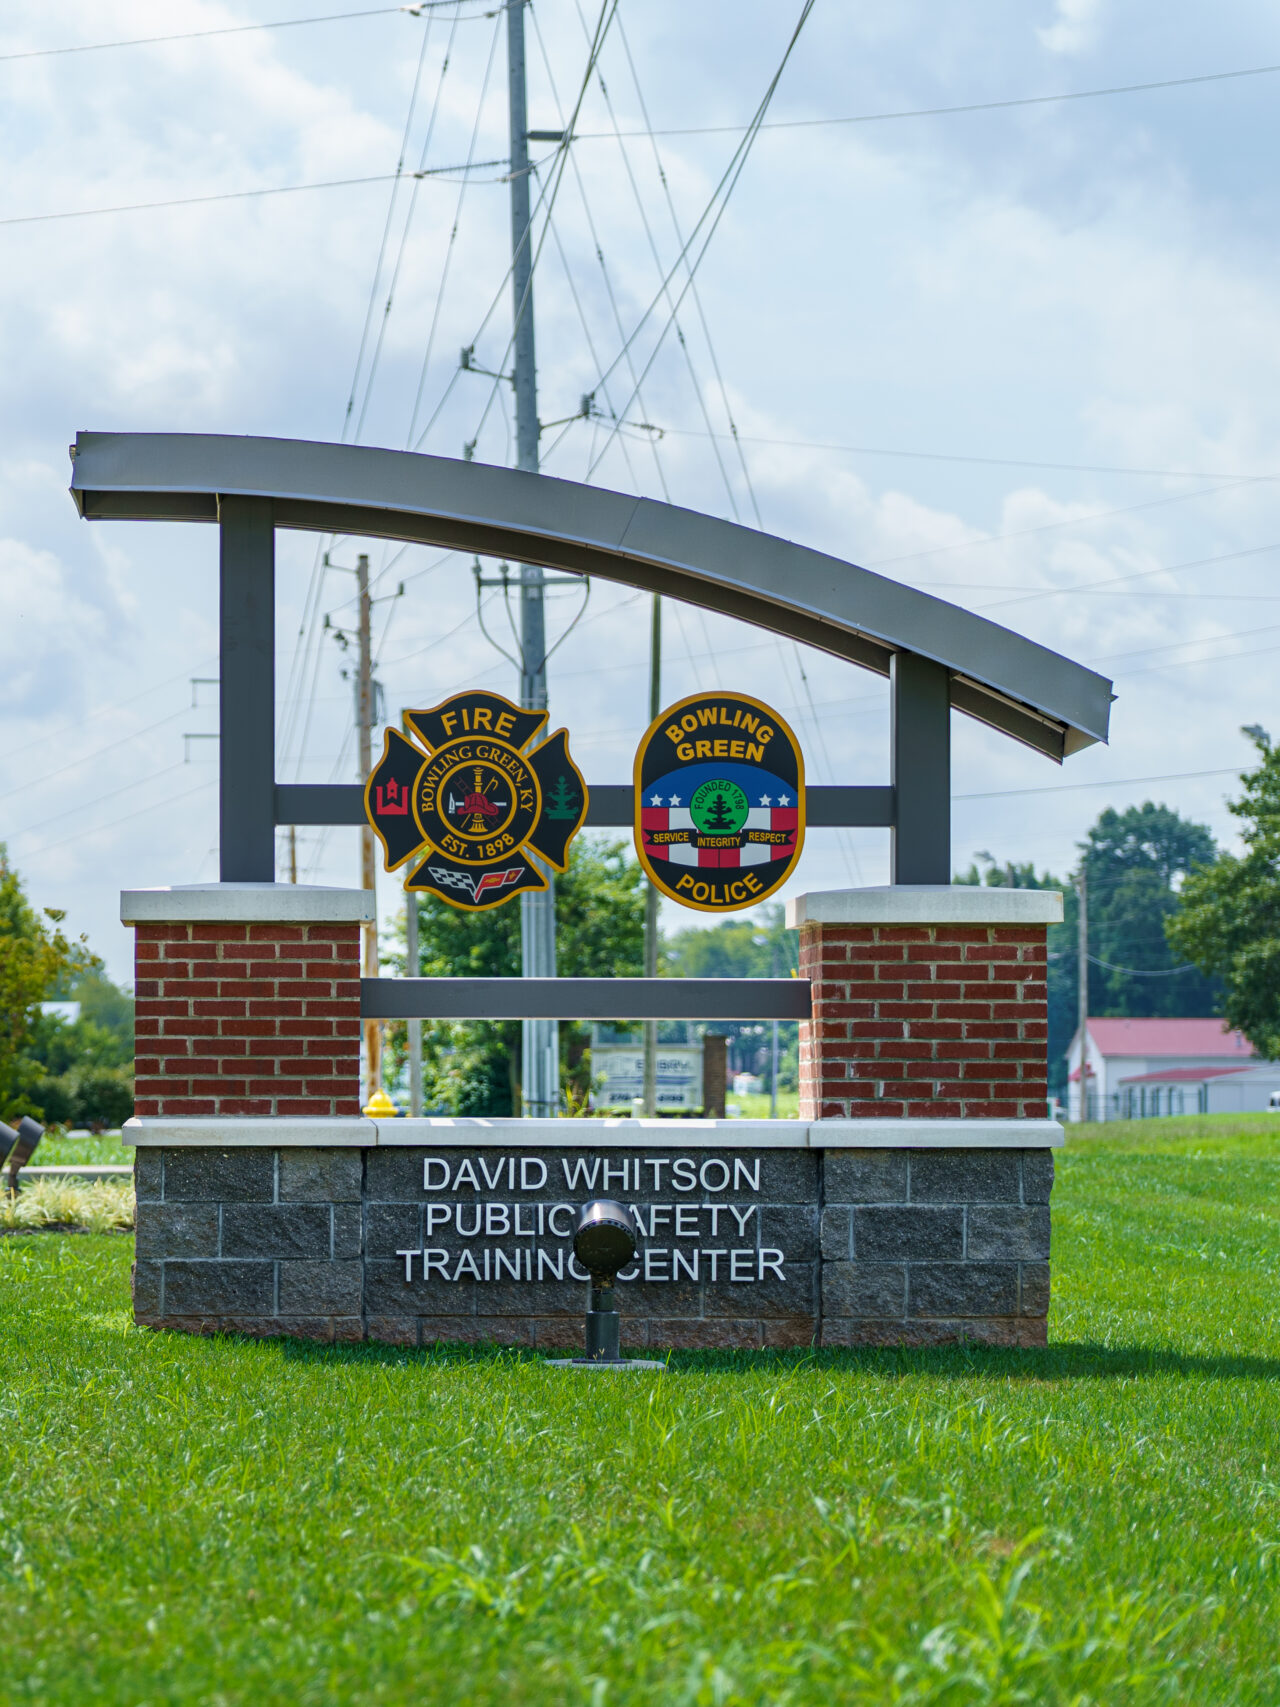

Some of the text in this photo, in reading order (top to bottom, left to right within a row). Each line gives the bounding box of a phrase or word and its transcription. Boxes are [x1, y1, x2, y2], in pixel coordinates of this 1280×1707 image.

[440, 707, 517, 738] FIRE
[665, 707, 774, 744] BOWLING
[676, 739, 765, 762] GREEN
[421, 745, 534, 813] BOWLING GREEN, KY
[694, 781, 745, 810] FOUNDED 1798
[440, 833, 515, 858] EST. 1898
[653, 832, 689, 843] SERVICE
[697, 836, 741, 847] INTEGRITY
[748, 831, 786, 843] RESPECT
[675, 872, 764, 903] POLICE
[423, 1157, 761, 1192] DAVID WHITSON
[426, 1203, 757, 1237] PUBLIC AFETY
